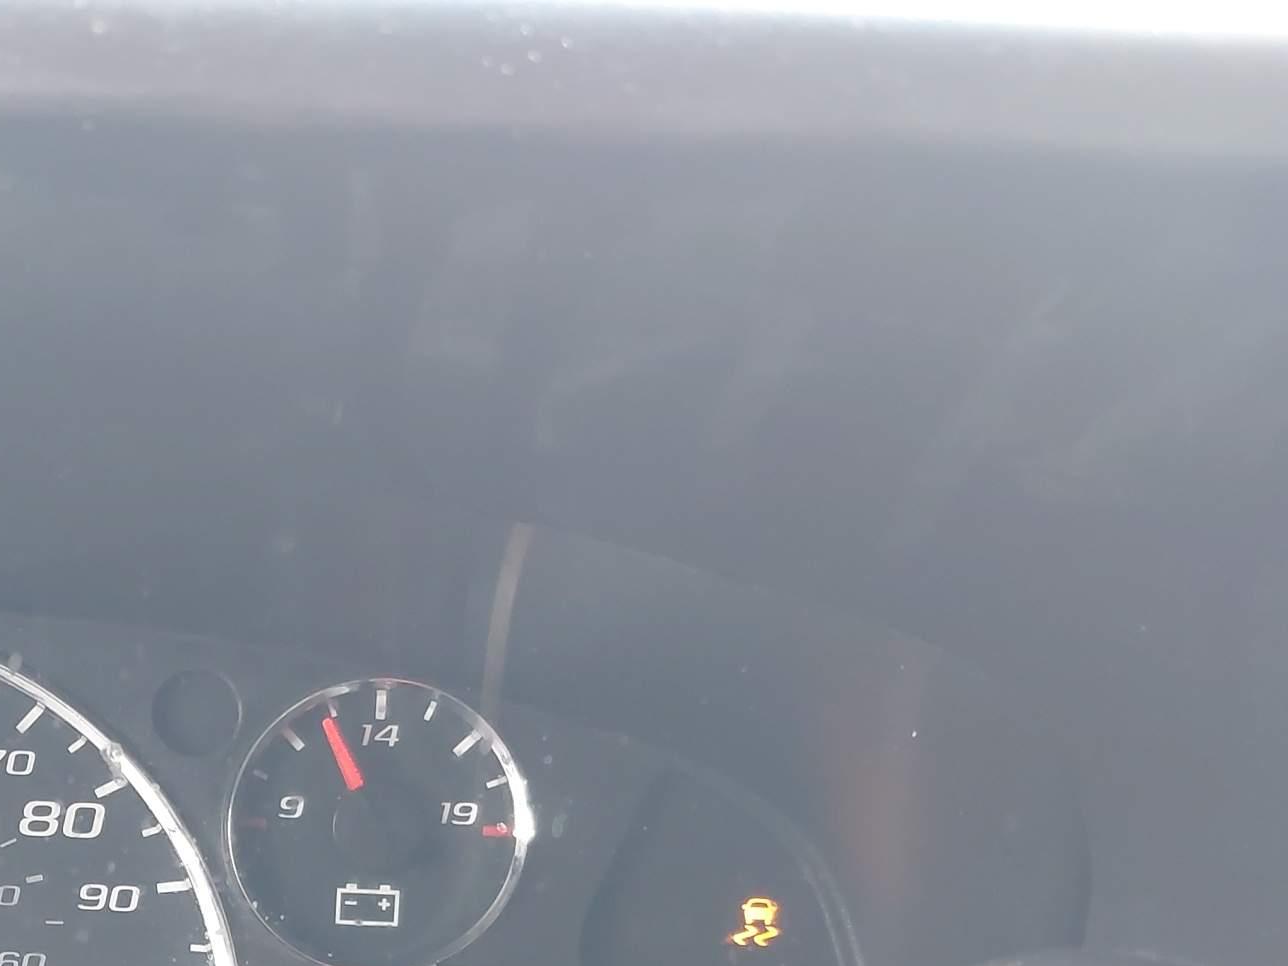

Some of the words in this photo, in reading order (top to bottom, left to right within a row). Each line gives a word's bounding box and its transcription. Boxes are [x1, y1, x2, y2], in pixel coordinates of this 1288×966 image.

[361, 723, 400, 747] 14
[18, 800, 106, 839] 80
[277, 796, 305, 820] 9
[439, 801, 479, 827] 19
[77, 883, 141, 913] 90
